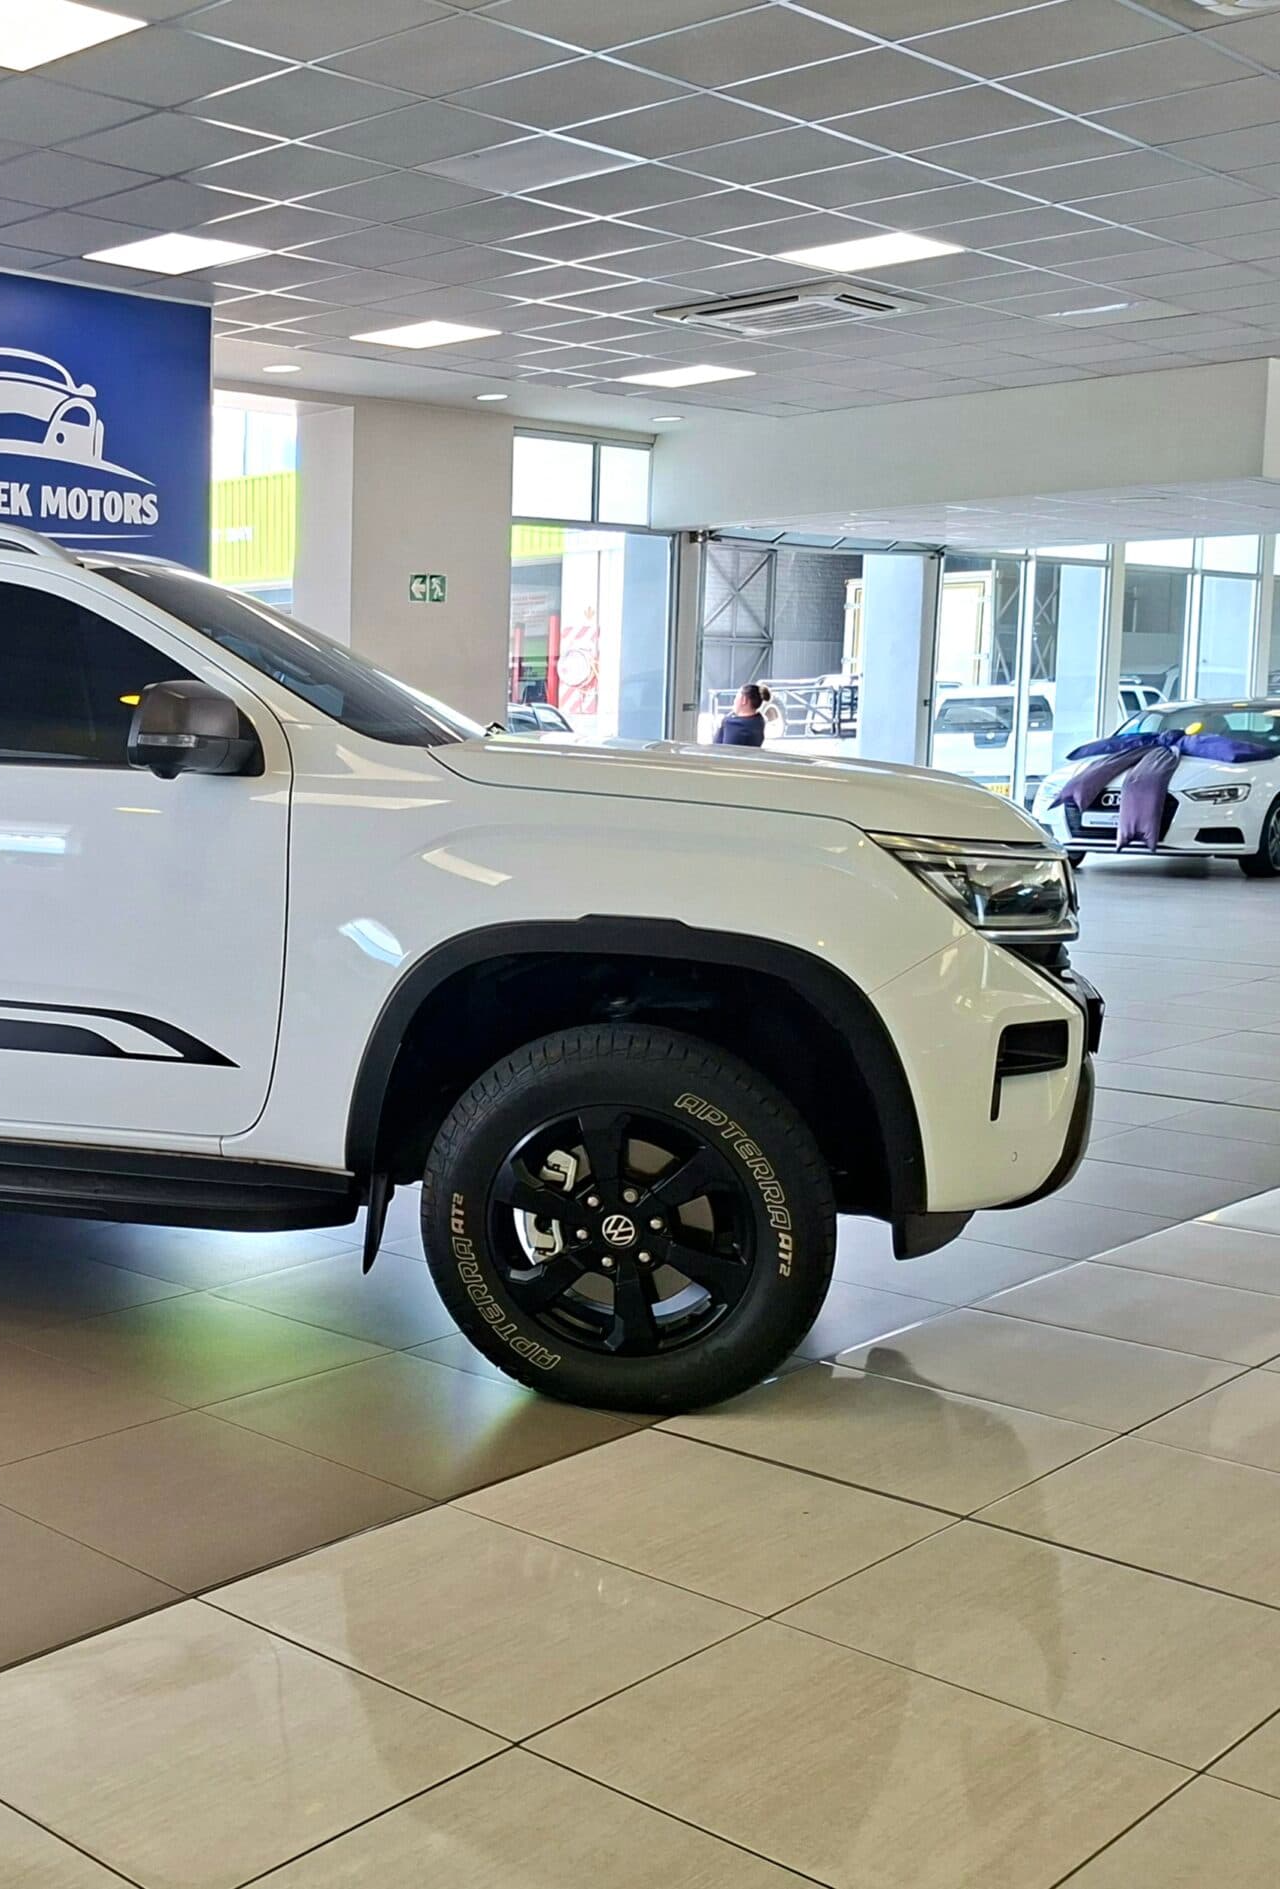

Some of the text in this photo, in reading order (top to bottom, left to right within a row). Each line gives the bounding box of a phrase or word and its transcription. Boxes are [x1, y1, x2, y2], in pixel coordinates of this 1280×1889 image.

[40, 485, 159, 526] MOTORS
[674, 1092, 792, 1231] APTERRA
[452, 1236, 561, 1371] APTERRA
